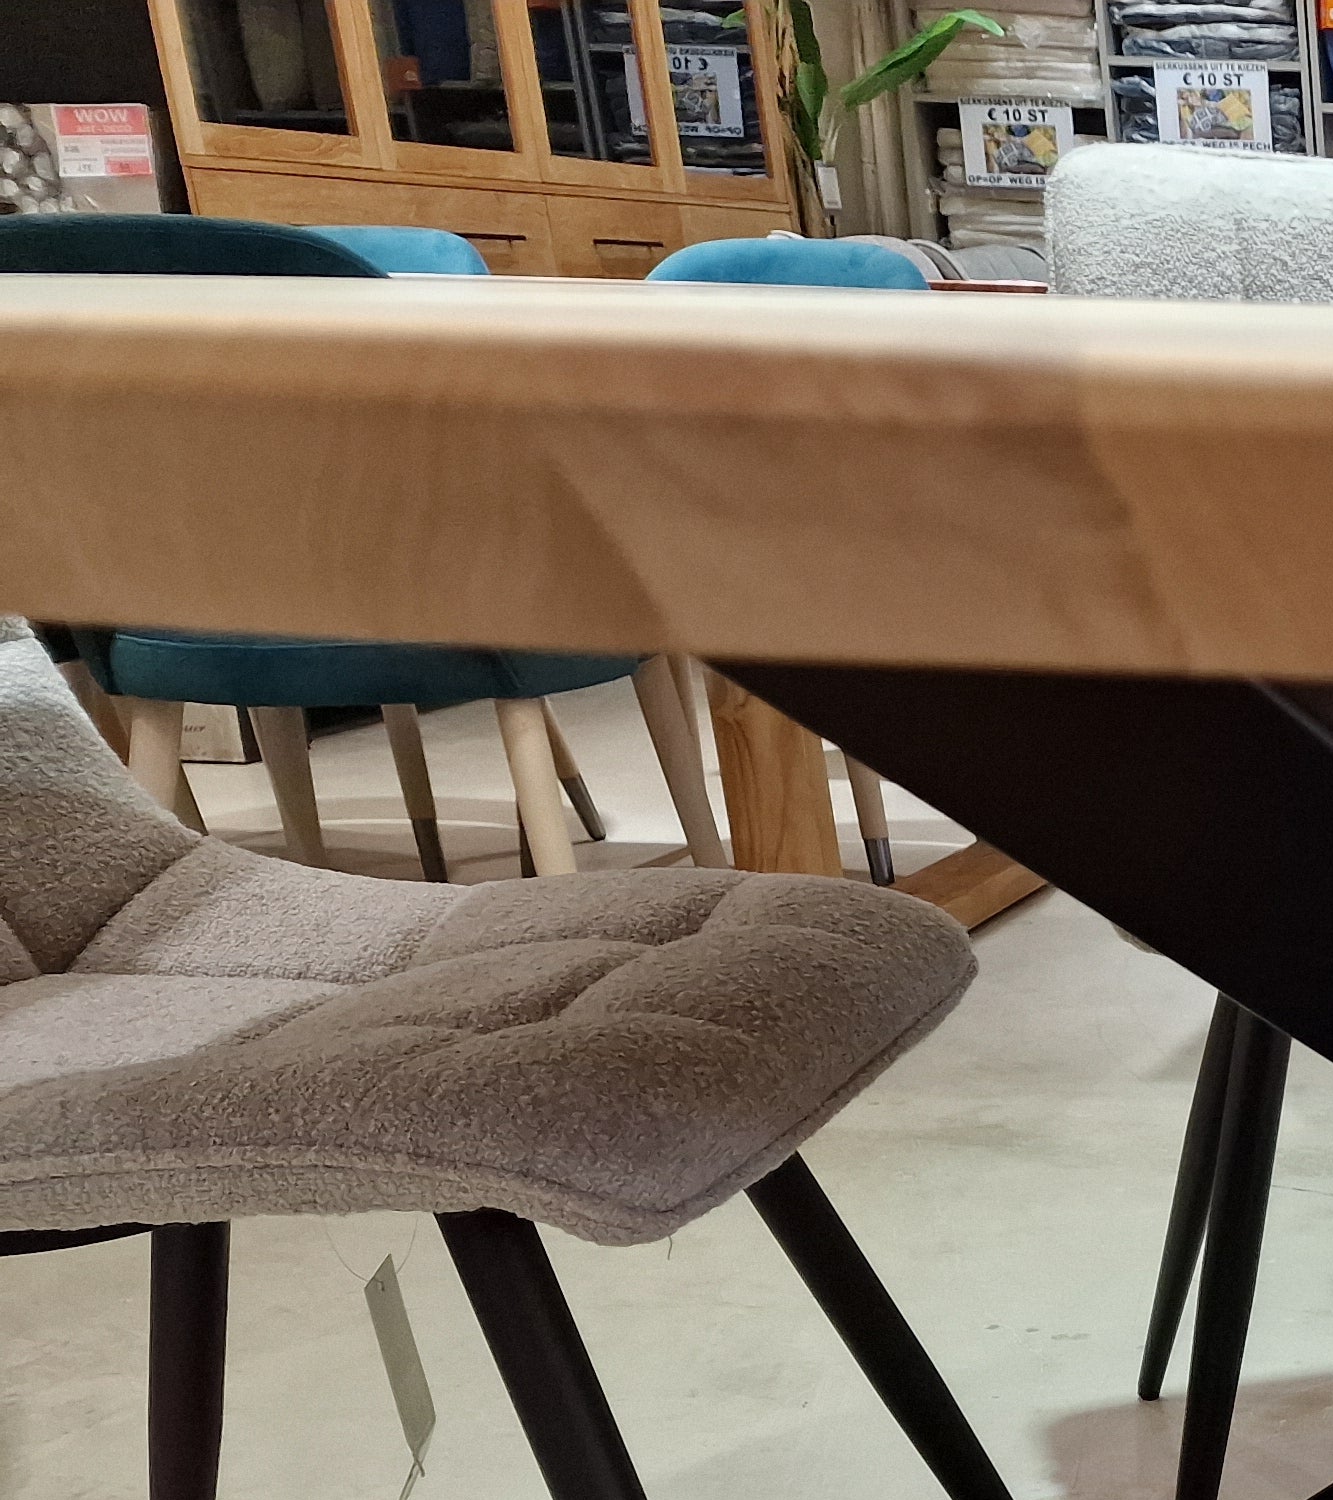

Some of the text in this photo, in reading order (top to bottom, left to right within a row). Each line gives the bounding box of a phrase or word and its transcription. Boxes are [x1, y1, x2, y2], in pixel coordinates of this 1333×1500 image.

[1198, 72, 1217, 86] 10
[1223, 73, 1244, 87] ST
[1003, 107, 1022, 122] 10
[1028, 108, 1049, 123] ST
[1008, 176, 1033, 186] WEG
